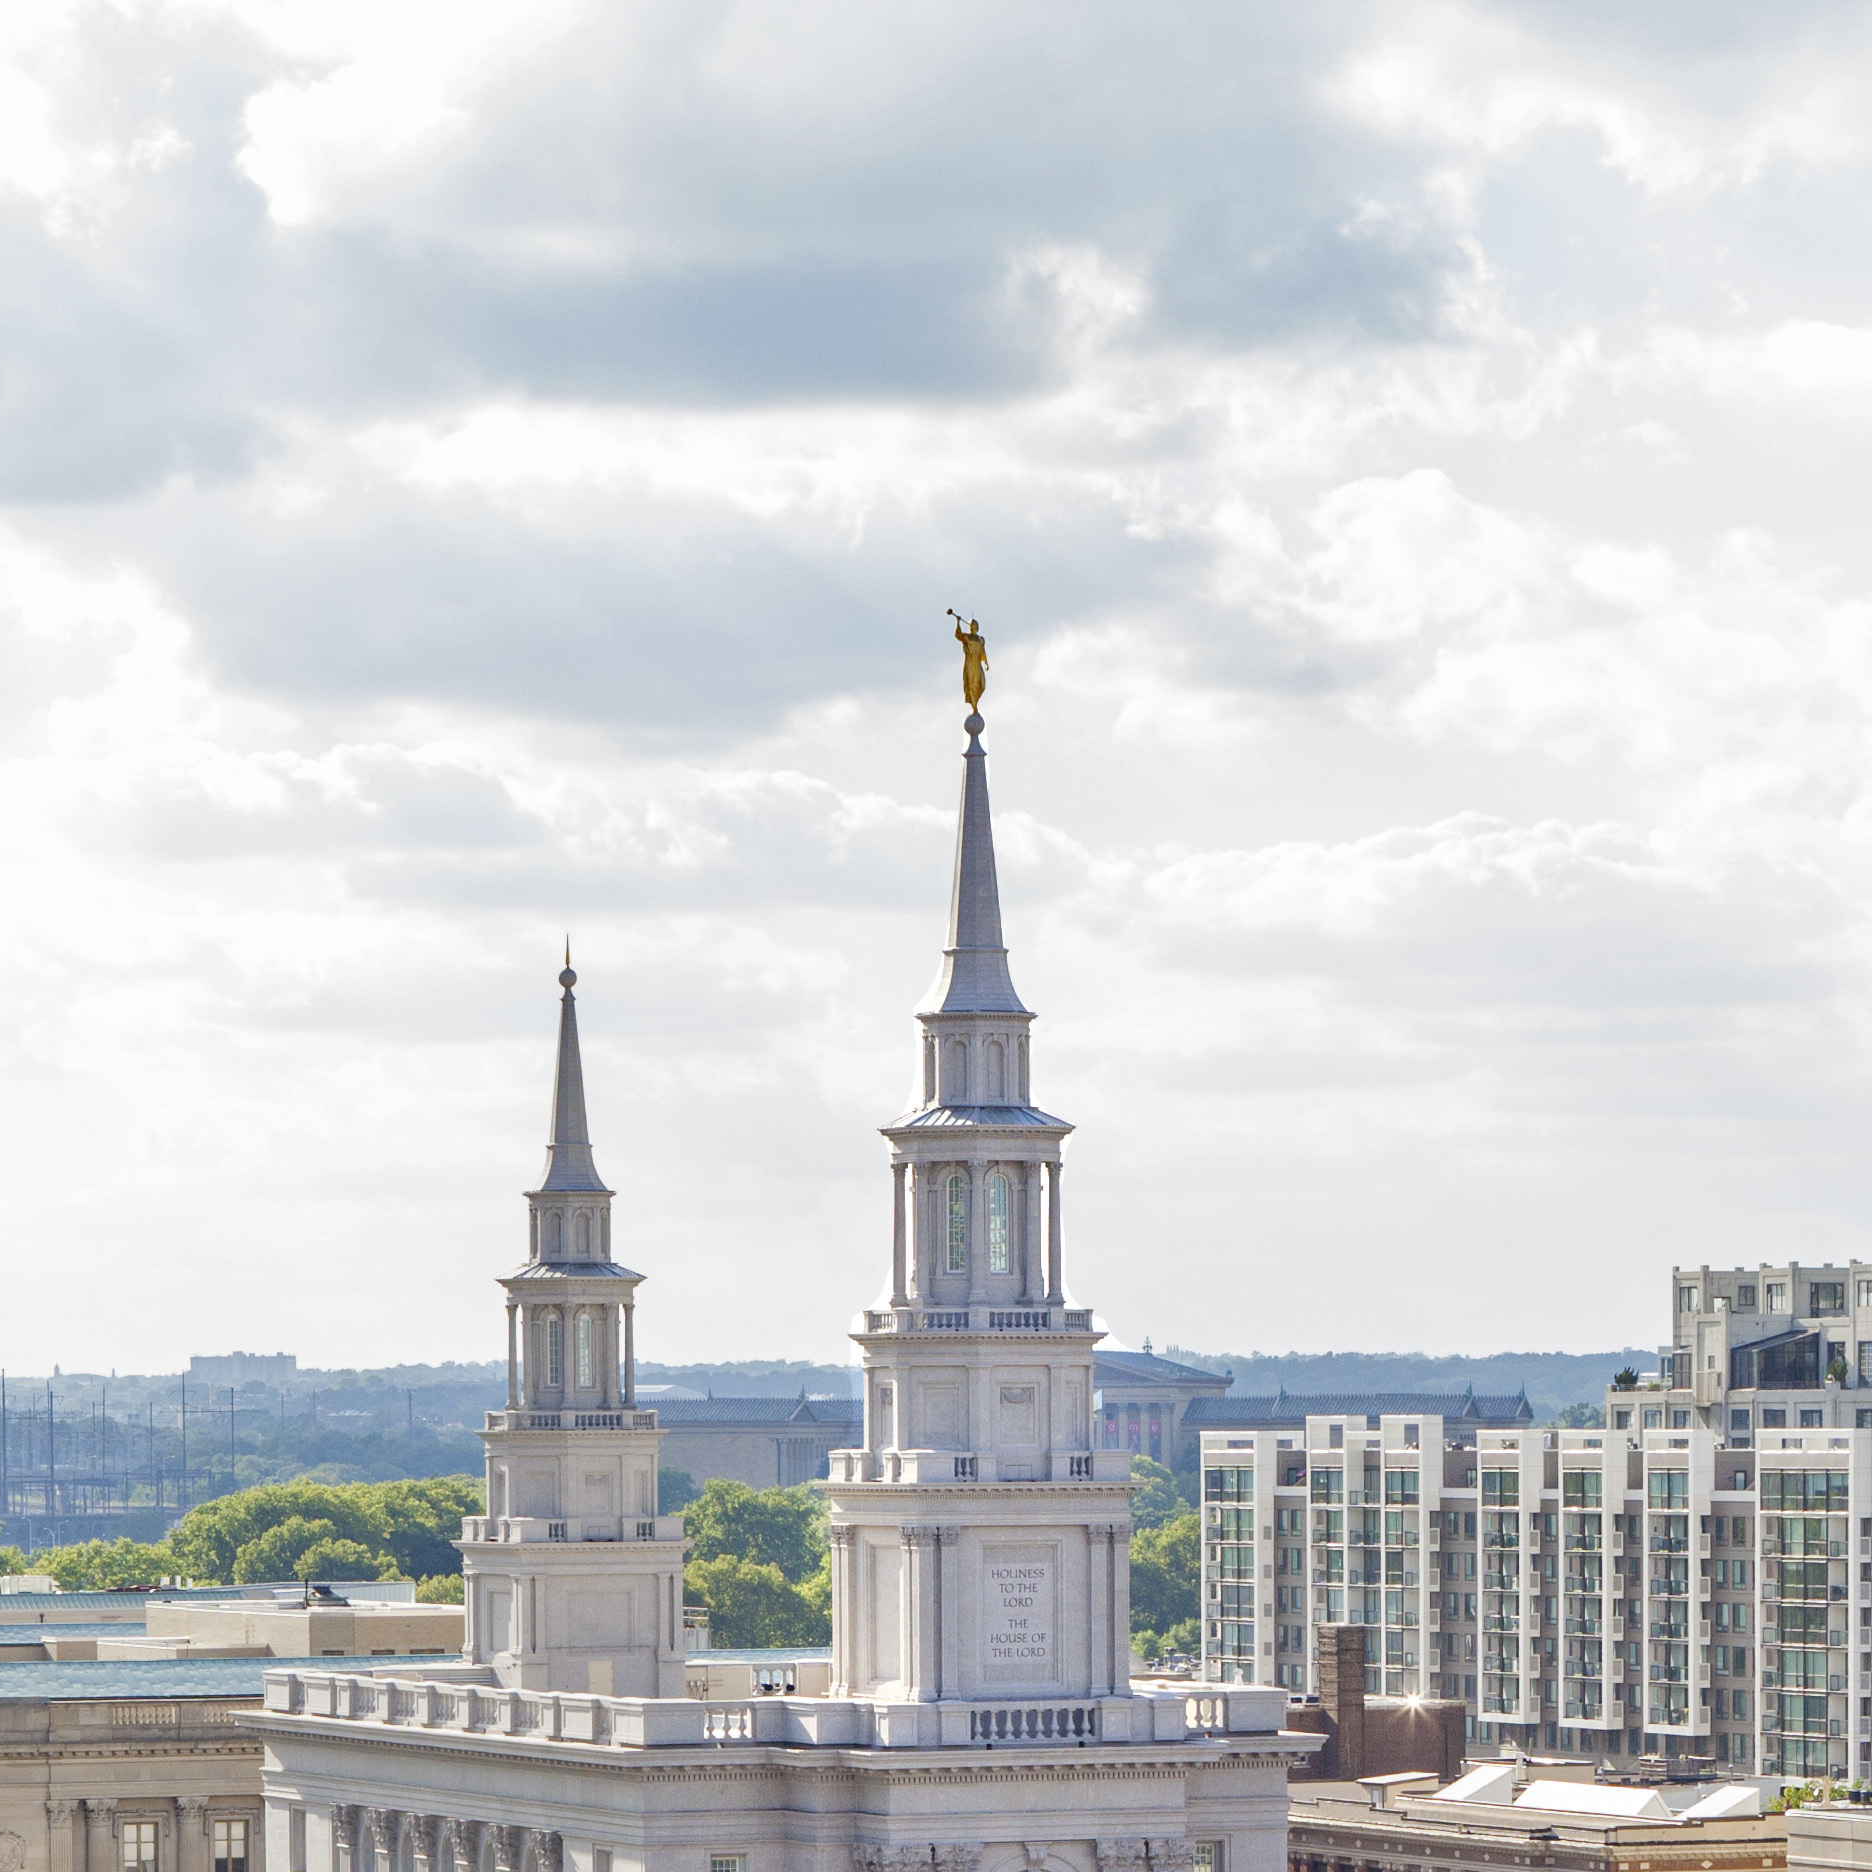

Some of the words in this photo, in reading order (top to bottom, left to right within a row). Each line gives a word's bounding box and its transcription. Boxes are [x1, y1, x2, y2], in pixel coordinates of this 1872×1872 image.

[991, 1569, 1045, 1579] HOLINESS
[999, 1583, 1015, 1593] TO
[1017, 1583, 1038, 1593] THE
[1004, 1597, 1033, 1607] LORD
[1008, 1619, 1029, 1629] THE
[990, 1633, 1028, 1643] HOUSE
[1031, 1632, 1046, 1643] OF
[992, 1647, 1013, 1657] THE
[1017, 1647, 1045, 1657] LORD
